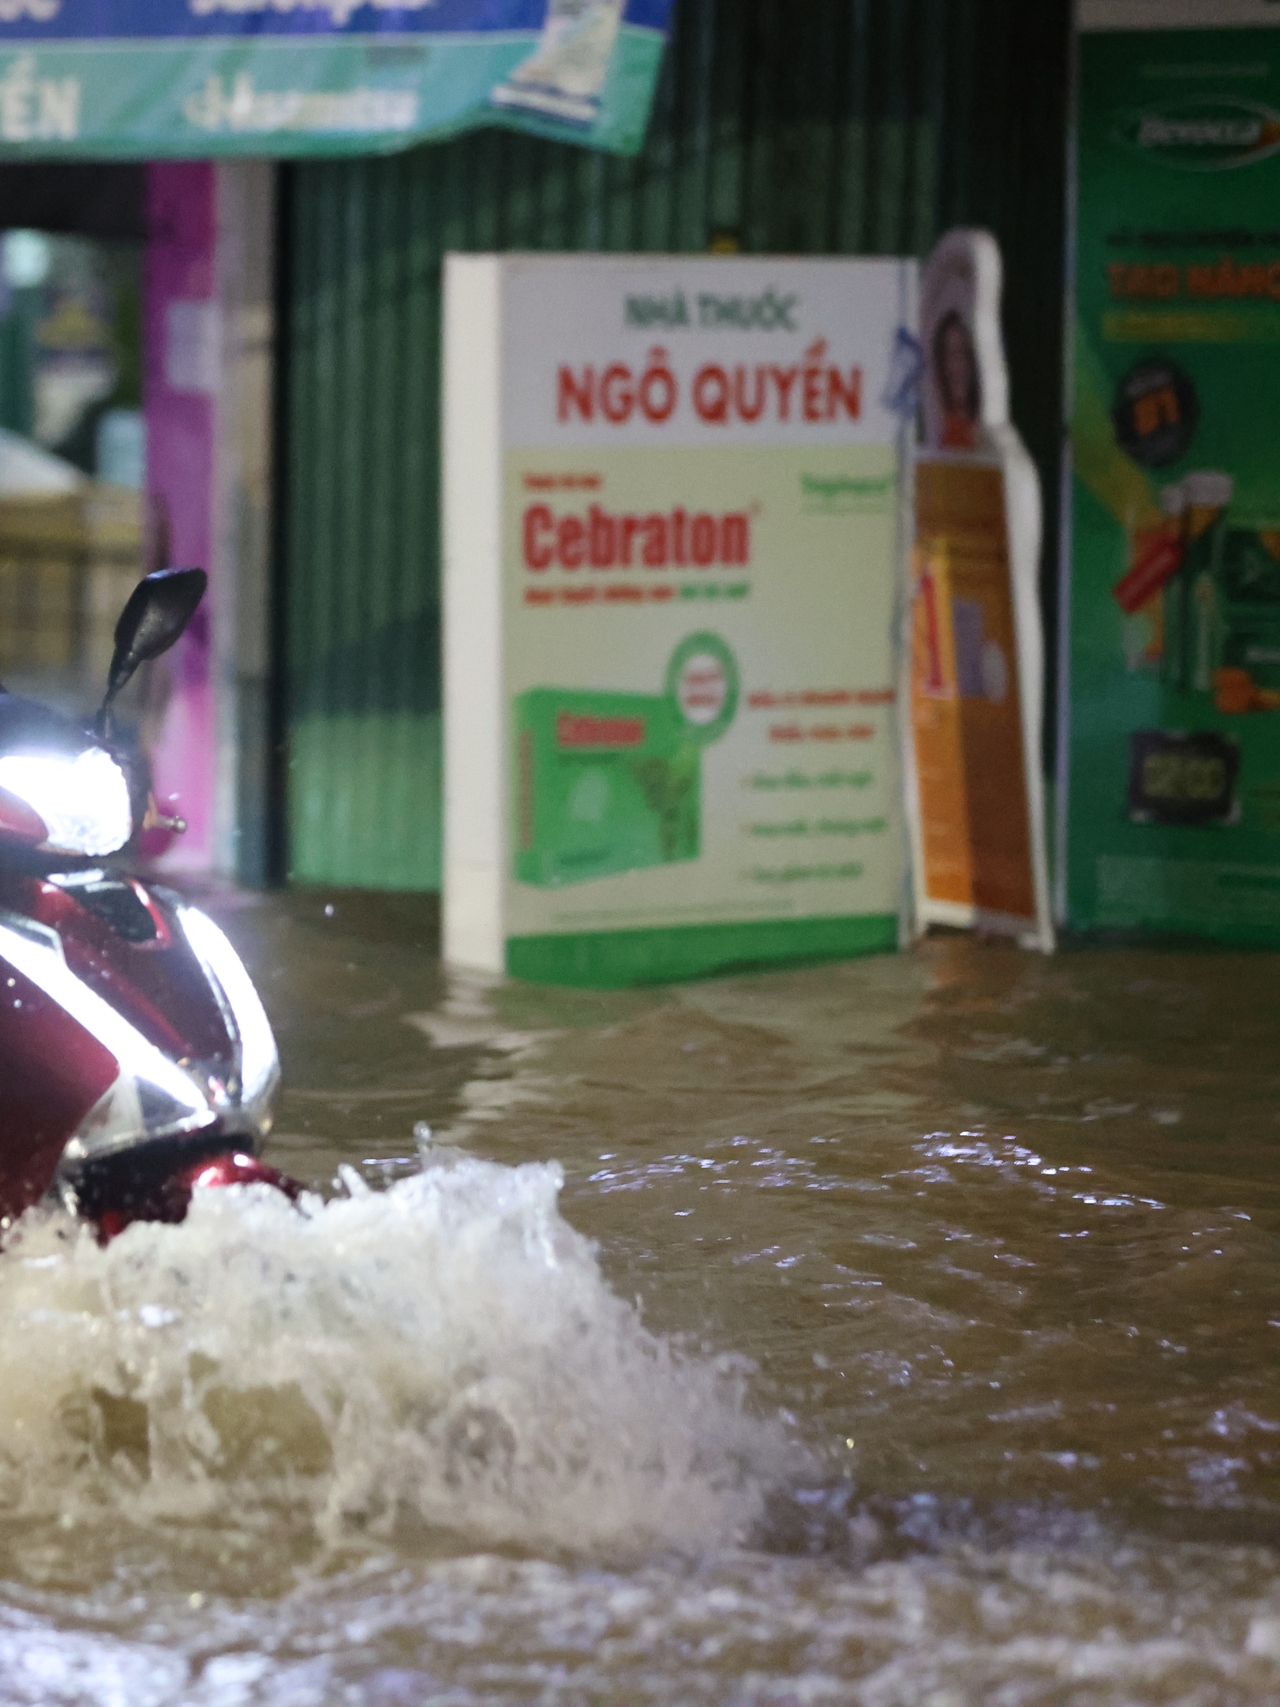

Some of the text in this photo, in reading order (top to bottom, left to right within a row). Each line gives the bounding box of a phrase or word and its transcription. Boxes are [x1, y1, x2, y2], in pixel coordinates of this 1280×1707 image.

[557, 334, 863, 427] NGÔ QUYỀN
[523, 502, 749, 571] Cebraton
